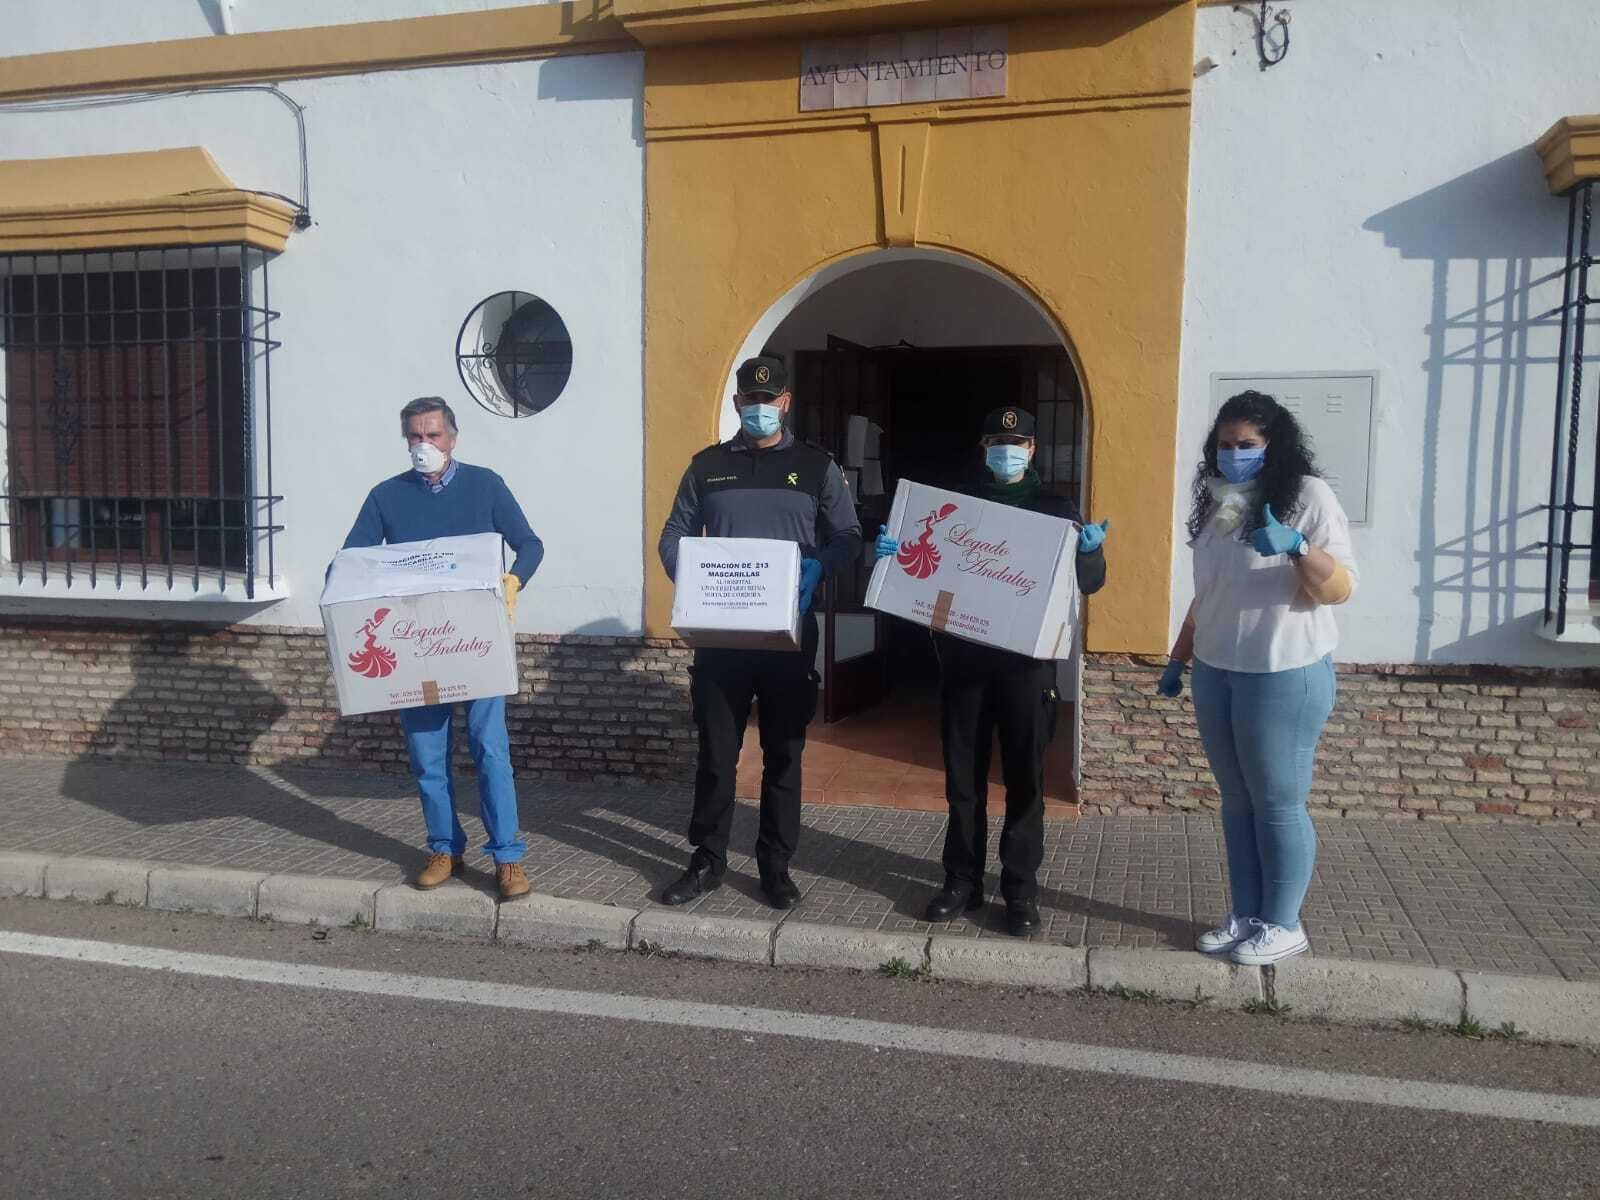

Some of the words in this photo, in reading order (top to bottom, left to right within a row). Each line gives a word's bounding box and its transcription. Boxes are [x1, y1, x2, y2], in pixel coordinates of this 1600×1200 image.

[802, 49, 1007, 87] AYUNTAMIENTO
[944, 523, 1009, 556] Legado
[957, 557, 1036, 596] Andaluz
[390, 619, 456, 642] Legado
[414, 638, 492, 658] Andaluz
